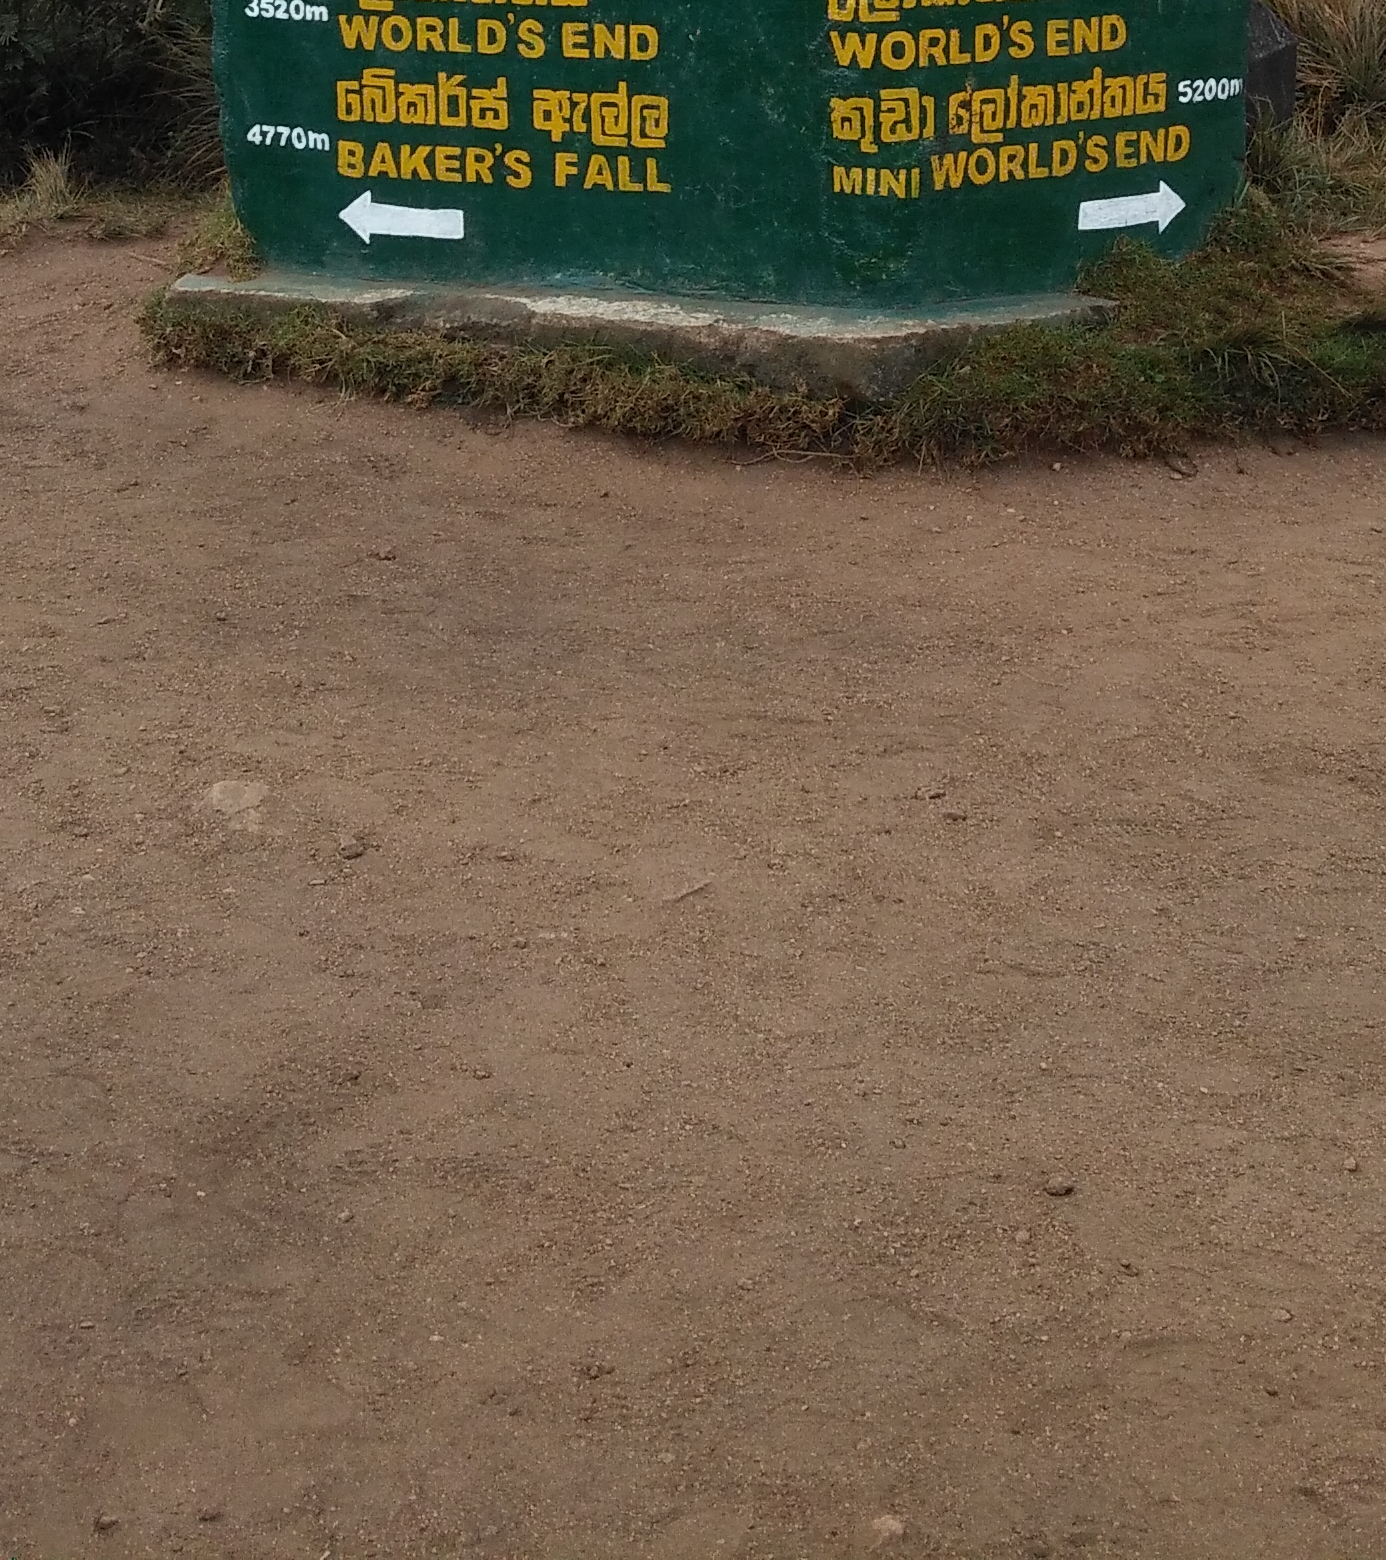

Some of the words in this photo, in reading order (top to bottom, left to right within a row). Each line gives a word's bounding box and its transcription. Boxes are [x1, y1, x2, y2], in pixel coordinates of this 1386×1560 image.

[339, 13, 545, 58] WORLD'S
[562, 23, 658, 60] END
[828, 13, 1034, 70] WORLD'S
[1047, 15, 1126, 56] END
[1178, 78, 1242, 102] 5200m
[247, 125, 329, 150] 4770m
[833, 166, 919, 198] MINI
[930, 130, 1108, 190] WORLD'S
[1116, 125, 1190, 167] END
[338, 140, 531, 188] BAKER'S
[555, 153, 669, 191] FALL
